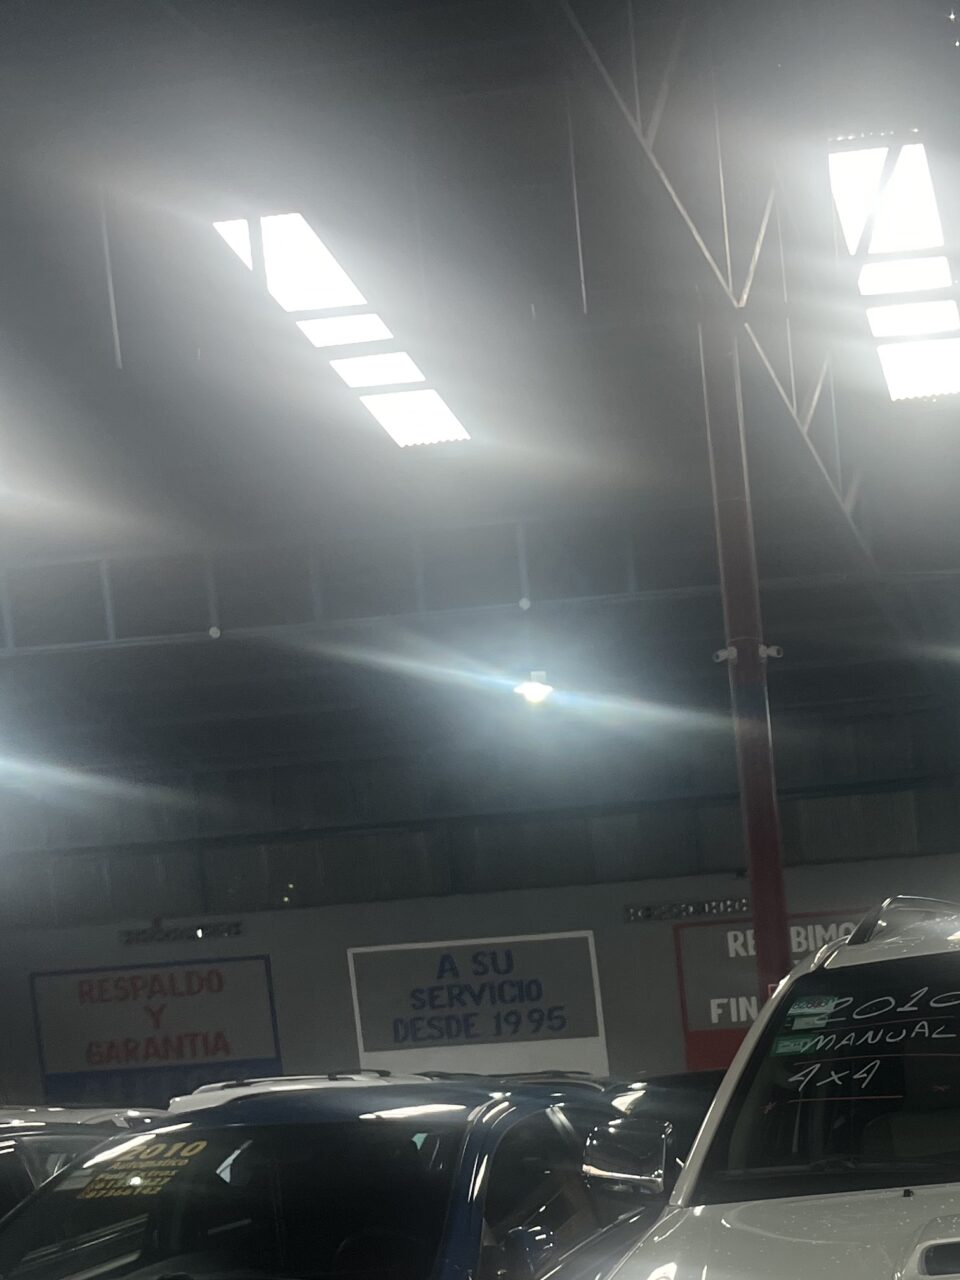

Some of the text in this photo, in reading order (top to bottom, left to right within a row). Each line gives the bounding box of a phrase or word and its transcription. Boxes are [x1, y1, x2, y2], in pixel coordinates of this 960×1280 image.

[436, 949, 514, 980] A SU
[77, 968, 225, 1005] RESPALDO
[410, 978, 543, 1011] SERVICIO
[143, 1002, 167, 1029] Y
[393, 1005, 567, 1044] DESDE 1995
[86, 1030, 231, 1066] GARANTIA
[800, 1020, 957, 1053] MANUAL
